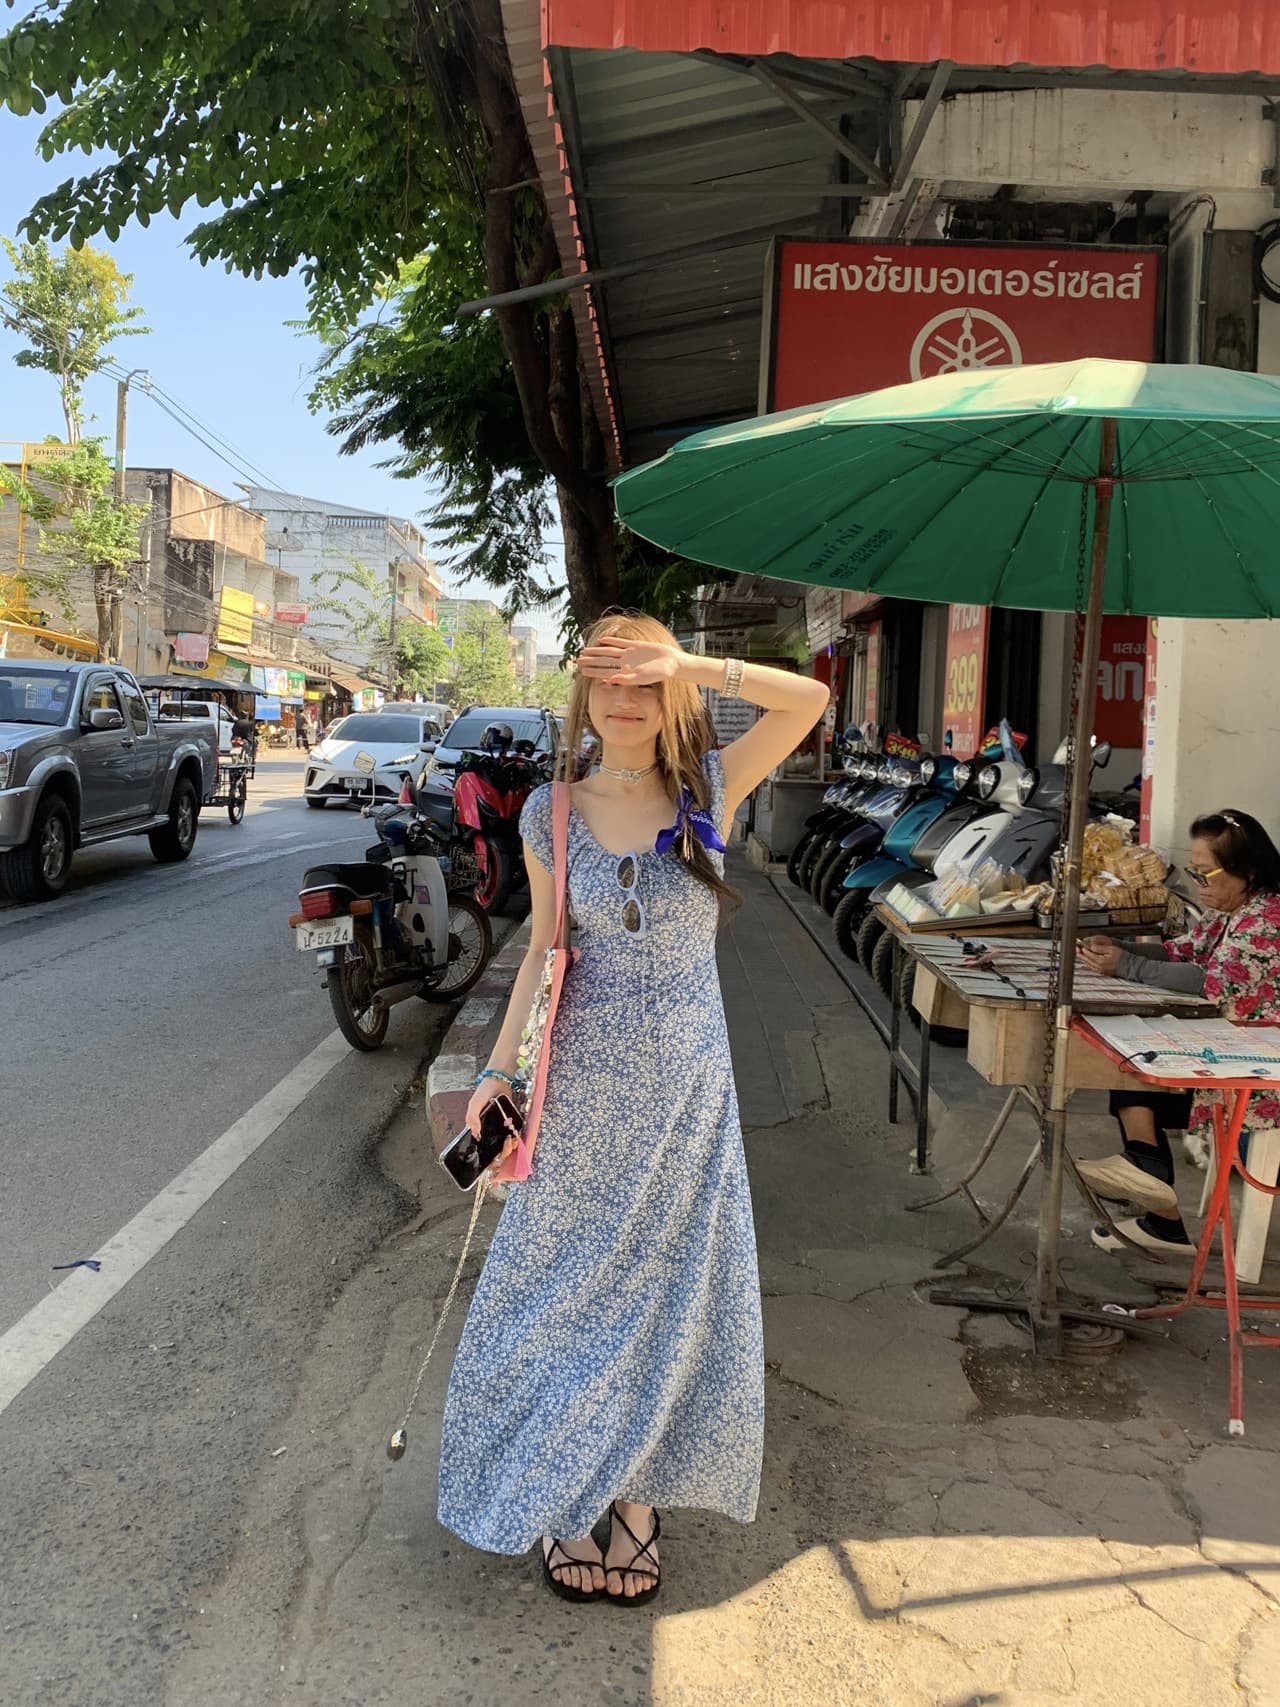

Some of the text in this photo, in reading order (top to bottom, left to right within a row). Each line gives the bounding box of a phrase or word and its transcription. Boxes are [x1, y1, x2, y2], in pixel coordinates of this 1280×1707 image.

[793, 255, 1144, 299] แสงชัยมอเตอร์เซลส์
[948, 653, 978, 713] 399
